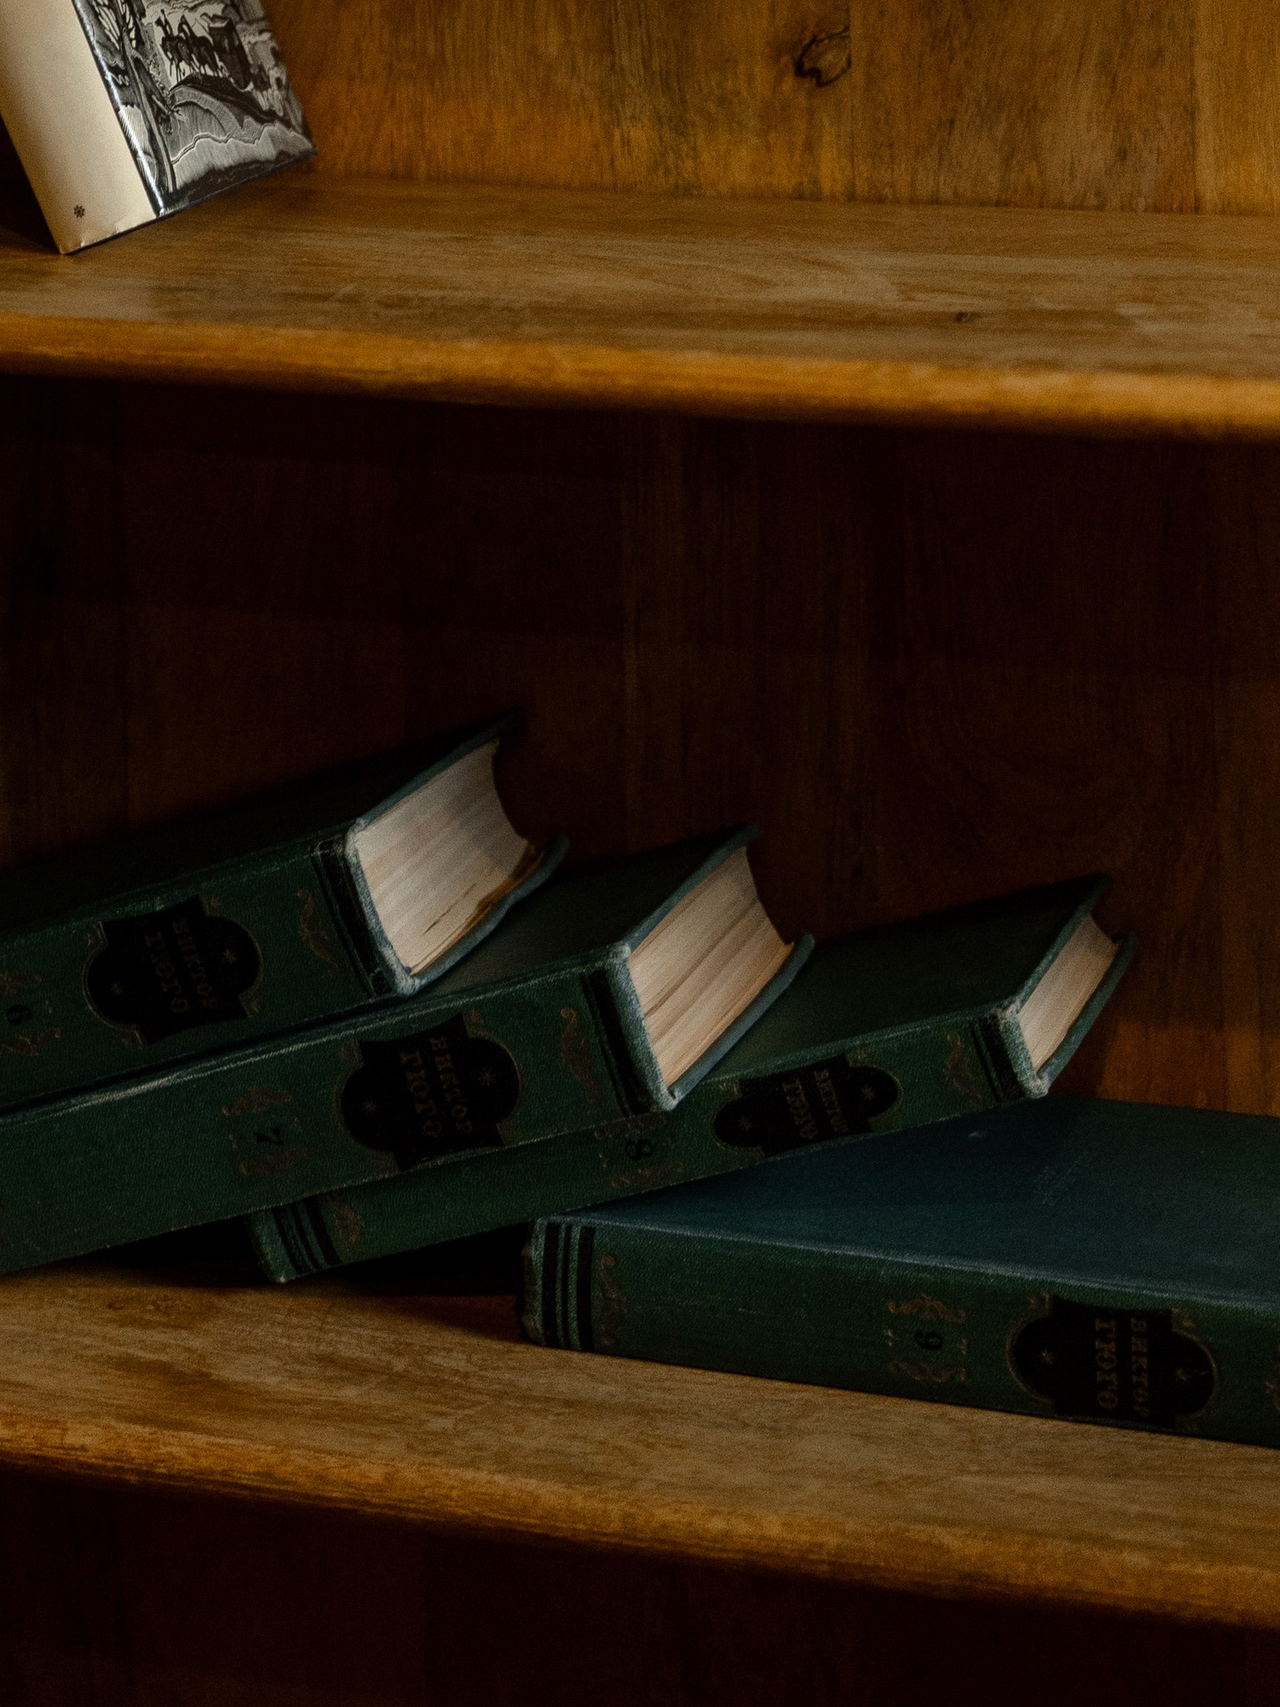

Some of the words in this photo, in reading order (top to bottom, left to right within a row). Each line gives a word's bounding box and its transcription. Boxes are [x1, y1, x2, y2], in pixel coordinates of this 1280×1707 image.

[144, 931, 192, 1015] ГЮГО
[172, 917, 220, 1010] ВИКТОР
[5, 1002, 33, 1027] 6
[399, 1048, 444, 1138] ГЮГО
[253, 1127, 286, 1147] 7
[625, 1139, 653, 1161] 8
[913, 1329, 945, 1351] 9
[1094, 1317, 1120, 1410] ГЮГО
[1129, 1316, 1153, 1420] ВИКТОР
